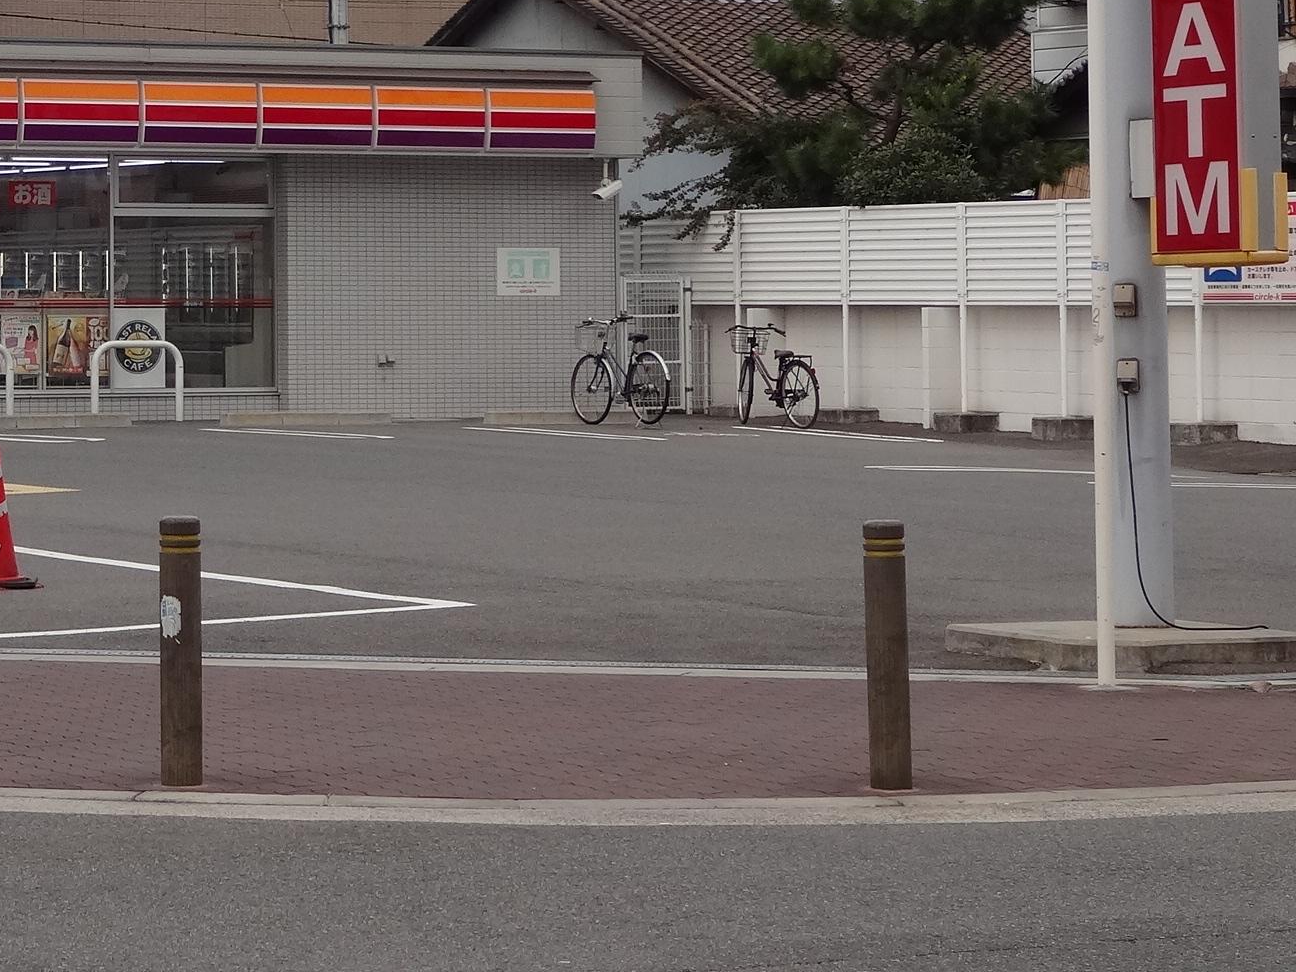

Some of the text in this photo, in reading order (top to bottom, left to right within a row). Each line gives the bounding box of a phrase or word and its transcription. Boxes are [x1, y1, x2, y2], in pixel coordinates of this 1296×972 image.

[13, 184, 52, 205] お酒
[1254, 293, 1281, 301] circle-k
[123, 358, 153, 372] CAFE
